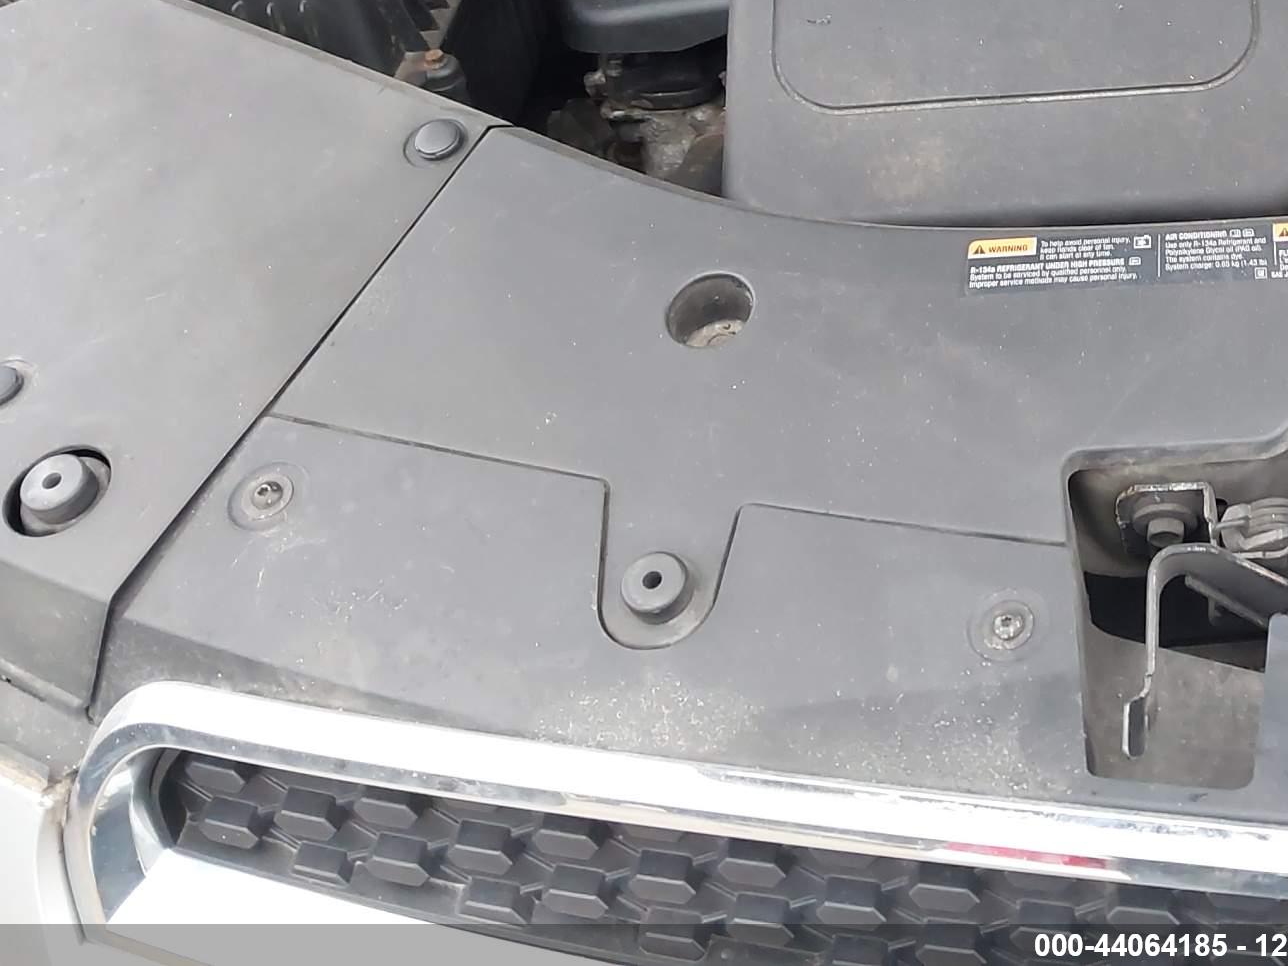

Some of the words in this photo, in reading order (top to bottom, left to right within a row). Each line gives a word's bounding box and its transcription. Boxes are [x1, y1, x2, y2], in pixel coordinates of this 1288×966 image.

[1165, 233, 1177, 241] AIR
[1179, 231, 1227, 240] CONDITIONING
[988, 245, 1028, 253] WARNING
